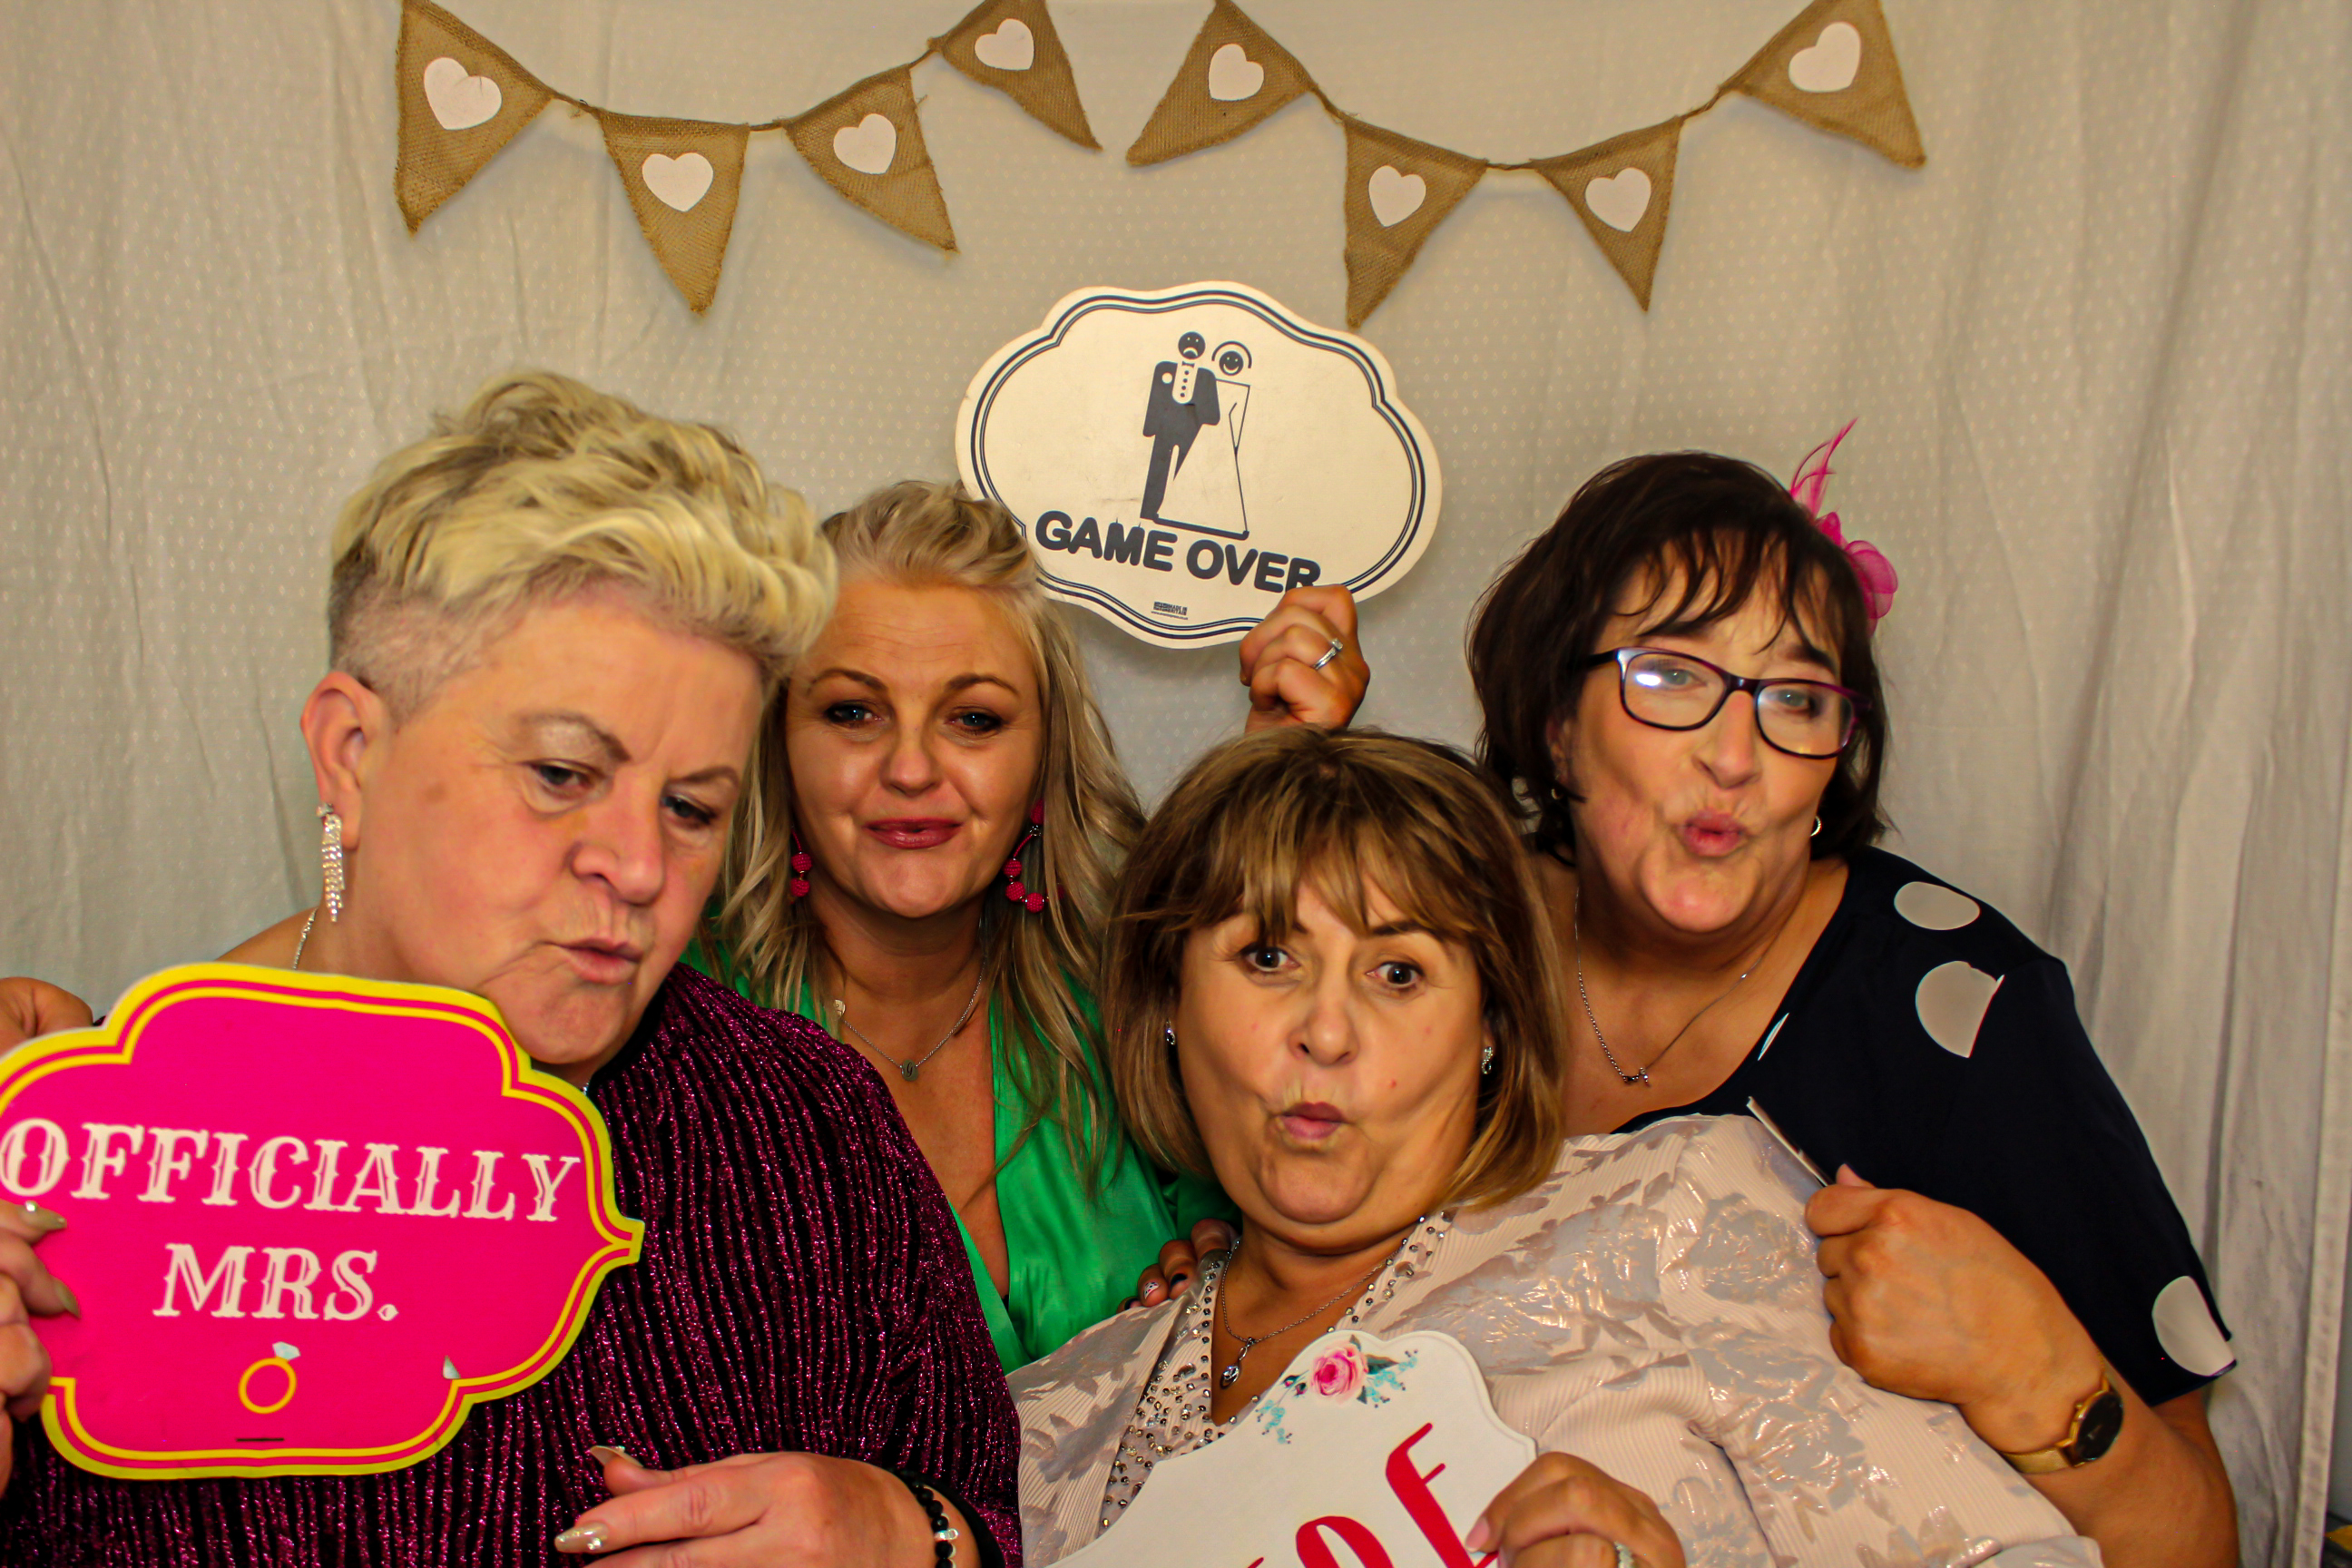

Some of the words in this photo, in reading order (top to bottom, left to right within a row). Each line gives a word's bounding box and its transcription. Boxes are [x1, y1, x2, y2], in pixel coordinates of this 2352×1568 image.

[1034, 510, 1178, 573] GAME
[1185, 539, 1321, 593] OVER
[0, 1117, 582, 1222] OFFICIALLY
[152, 1242, 399, 1322] MRS.
